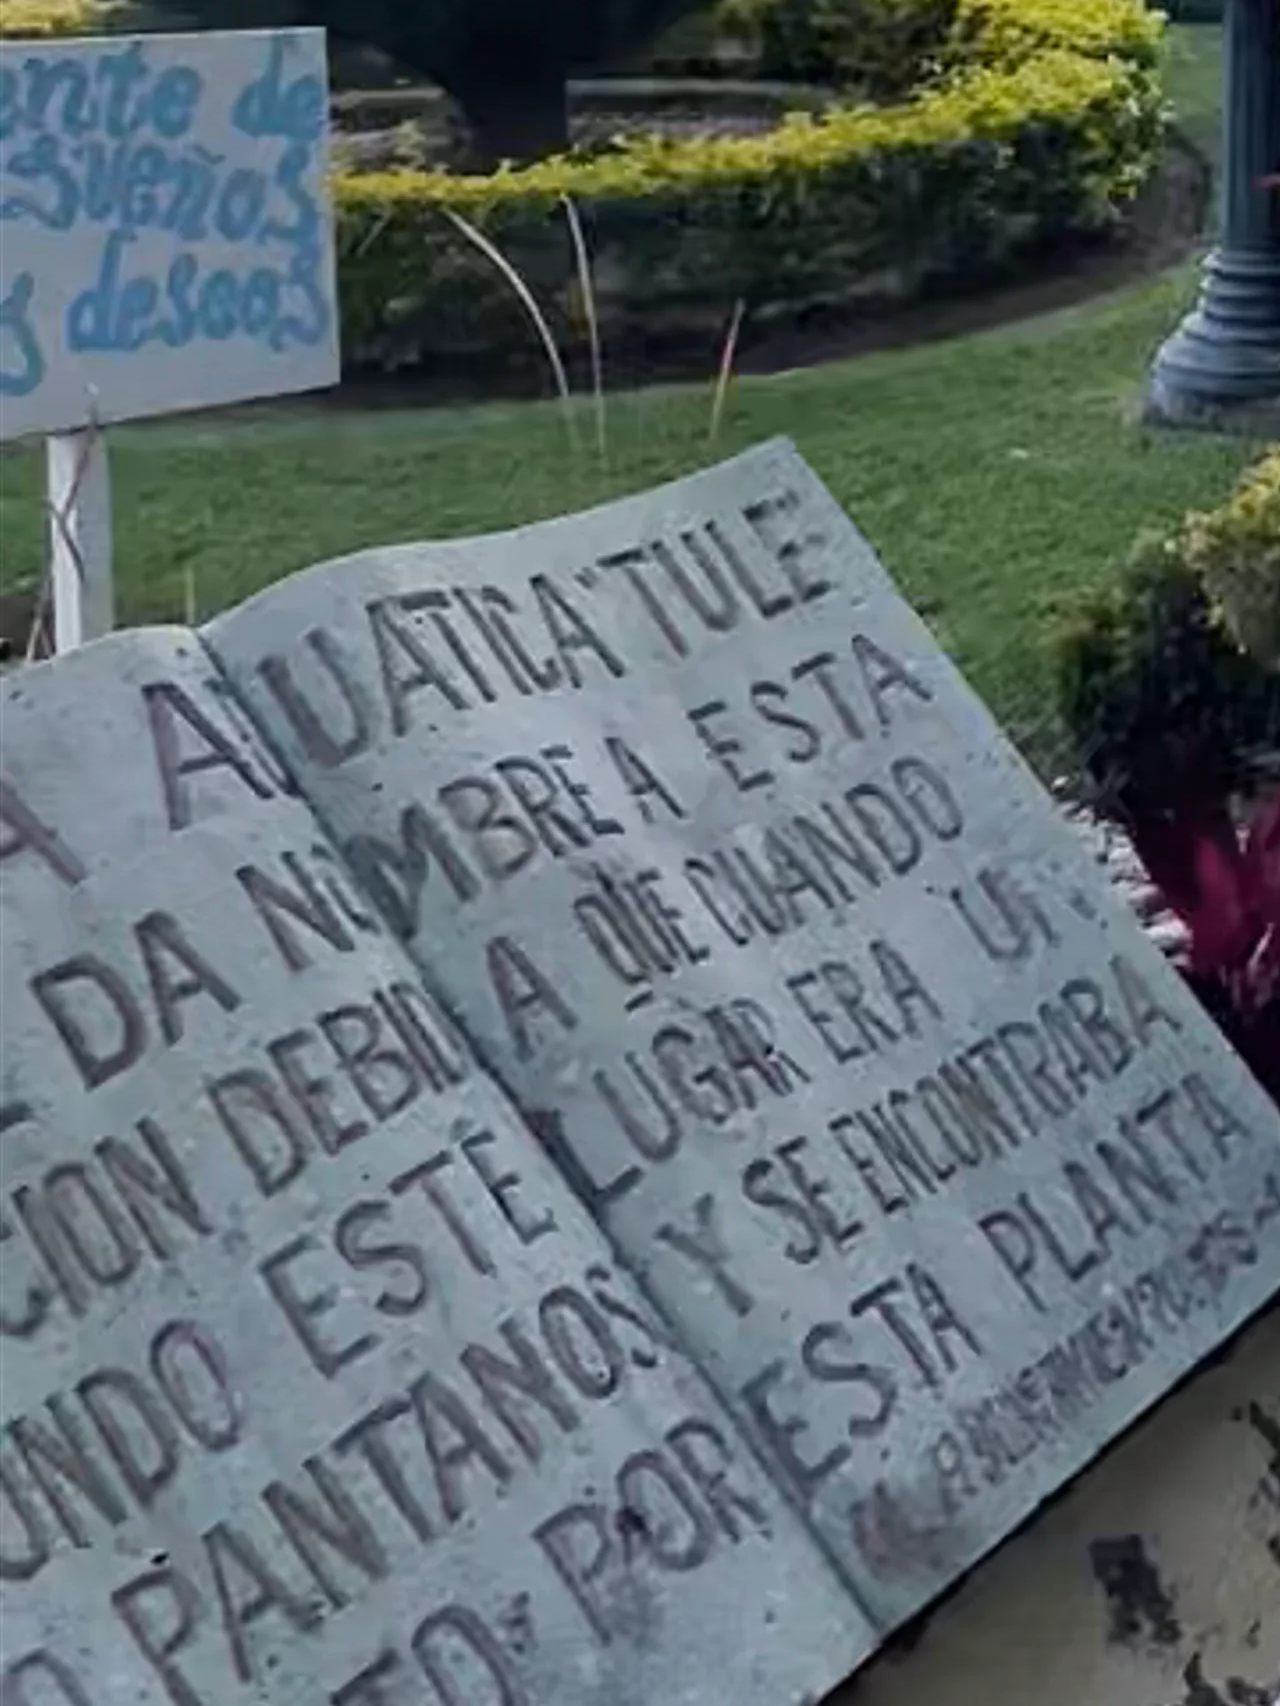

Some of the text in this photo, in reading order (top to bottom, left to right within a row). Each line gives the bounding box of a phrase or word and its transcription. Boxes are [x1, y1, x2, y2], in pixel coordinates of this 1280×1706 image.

[229, 32, 326, 140] de
[28, 908, 243, 1091] DA
[605, 736, 688, 825] A
[687, 632, 936, 792] ESTA
[485, 933, 579, 1061] A
[573, 870, 710, 1013] QUE
[684, 756, 964, 948] CUANDO
[258, 1128, 558, 1380] ESTE
[525, 995, 812, 1198] LUGAR
[786, 938, 943, 1065] ERA
[653, 1193, 757, 1317] Y
[741, 1137, 864, 1266] SE
[828, 953, 1183, 1216] ENCONTRABA
[532, 1416, 773, 1648] POR
[741, 1263, 982, 1480] ESTA
[978, 1072, 1257, 1315] PLANTA
